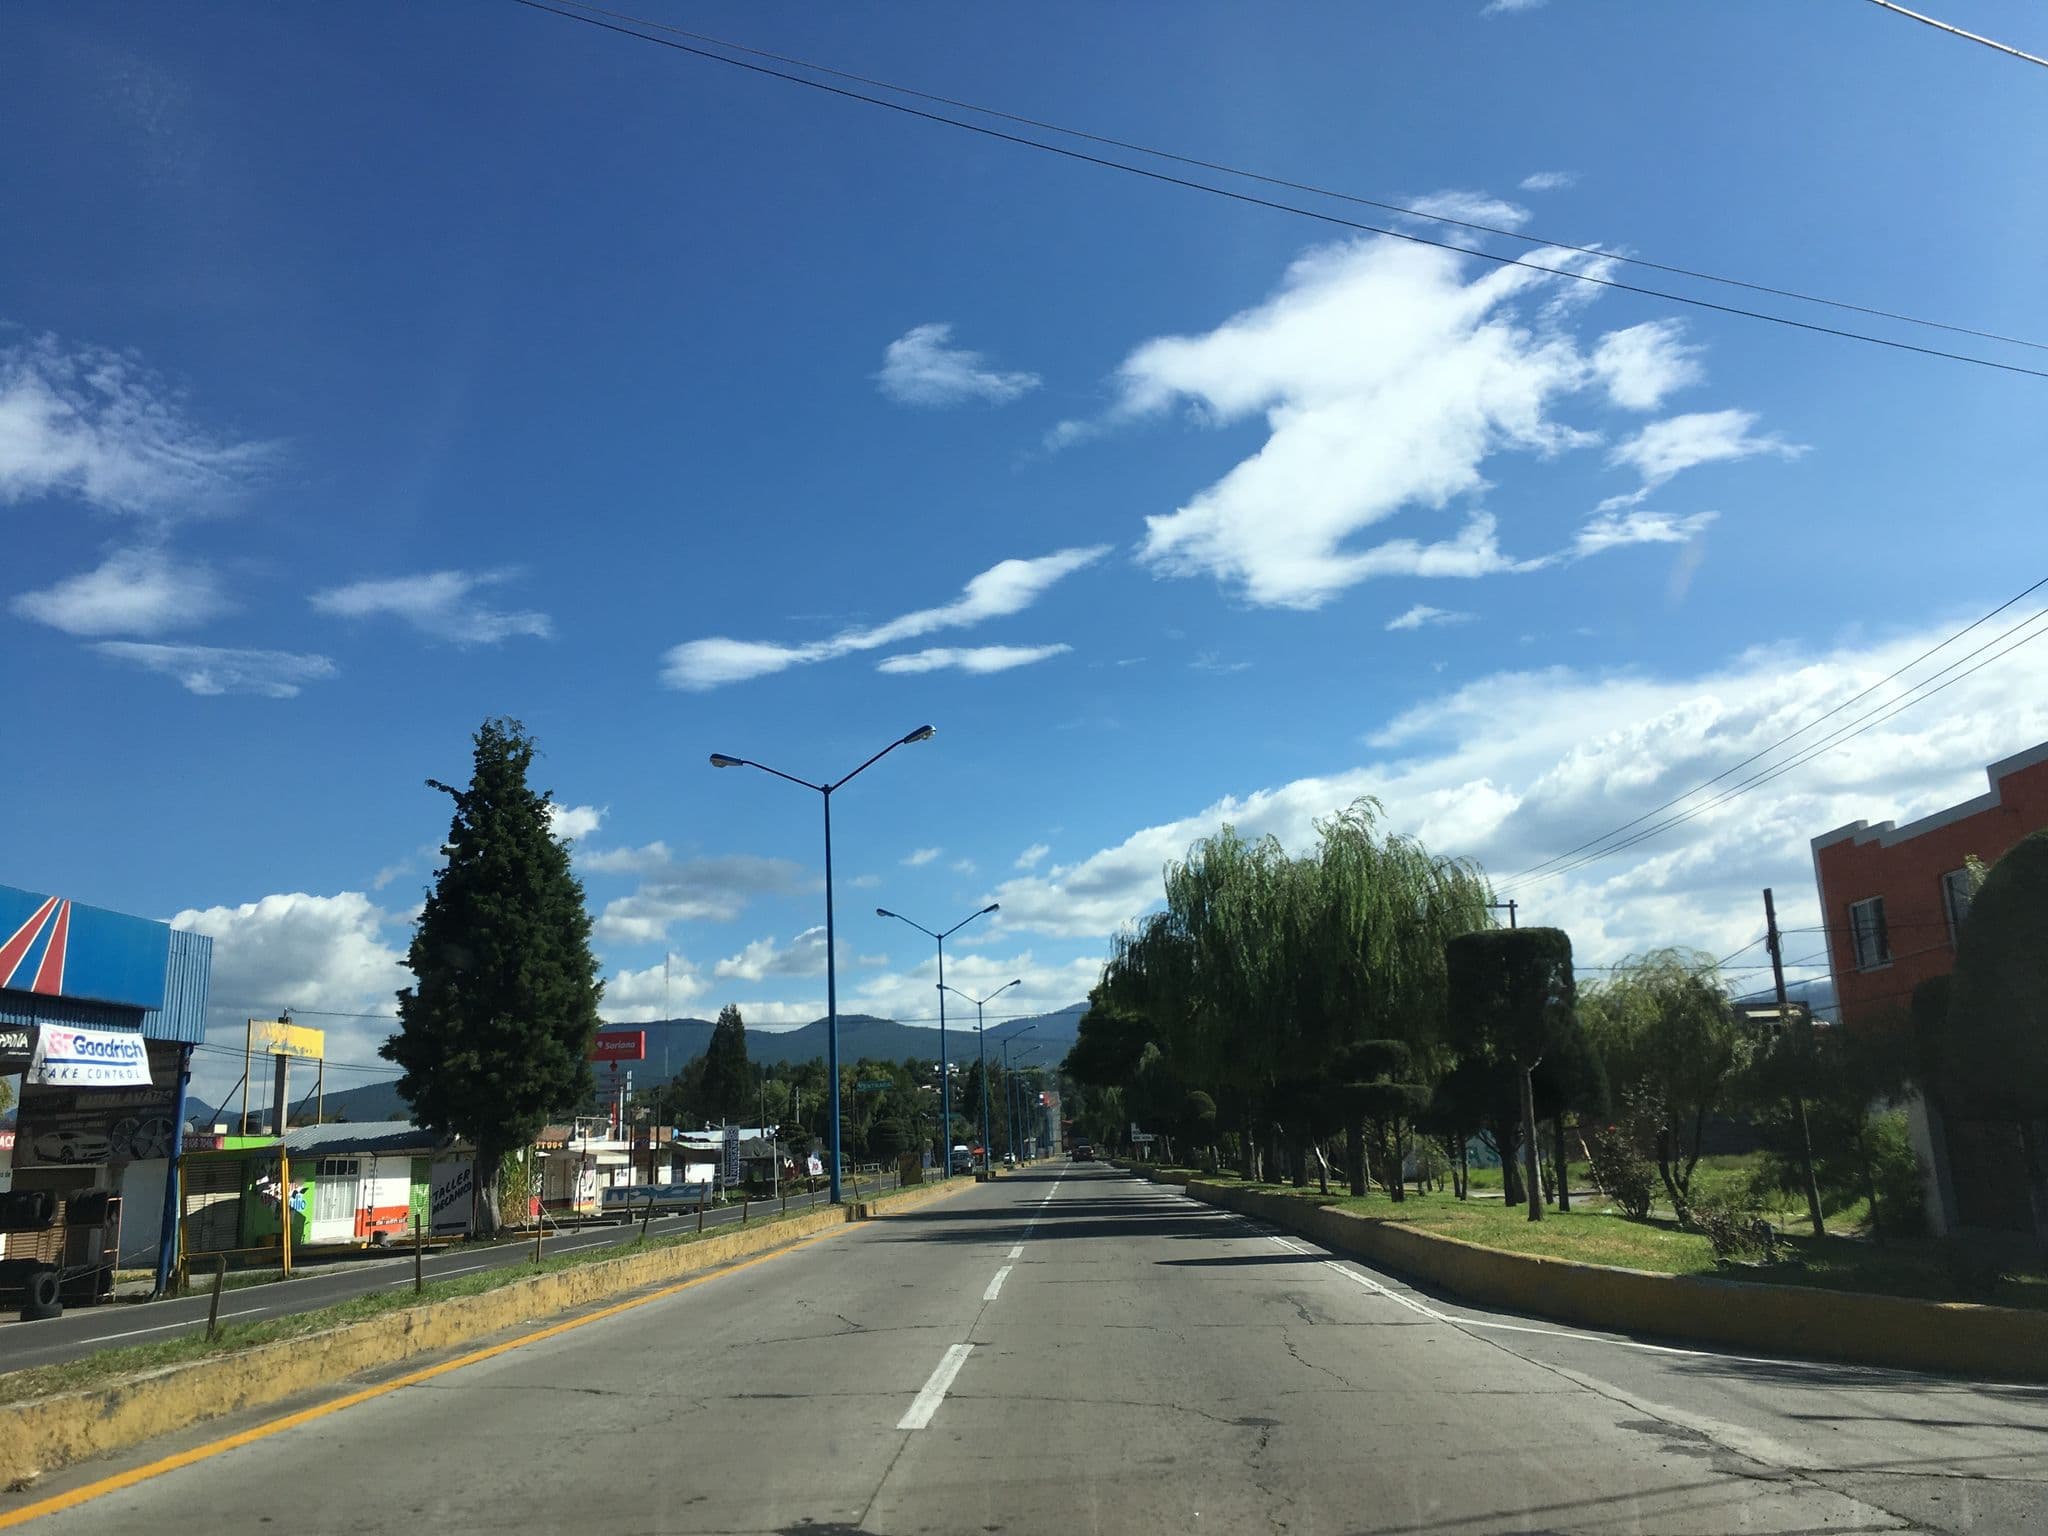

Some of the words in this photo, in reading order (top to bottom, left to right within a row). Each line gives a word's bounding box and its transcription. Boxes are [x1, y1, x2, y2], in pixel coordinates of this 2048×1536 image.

[605, 1041, 636, 1050] Soriana
[37, 1067, 79, 1079] TAKE
[87, 1068, 140, 1079] CONTROL
[432, 1168, 470, 1202] TALLER
[432, 1181, 472, 1214] MECANICO
